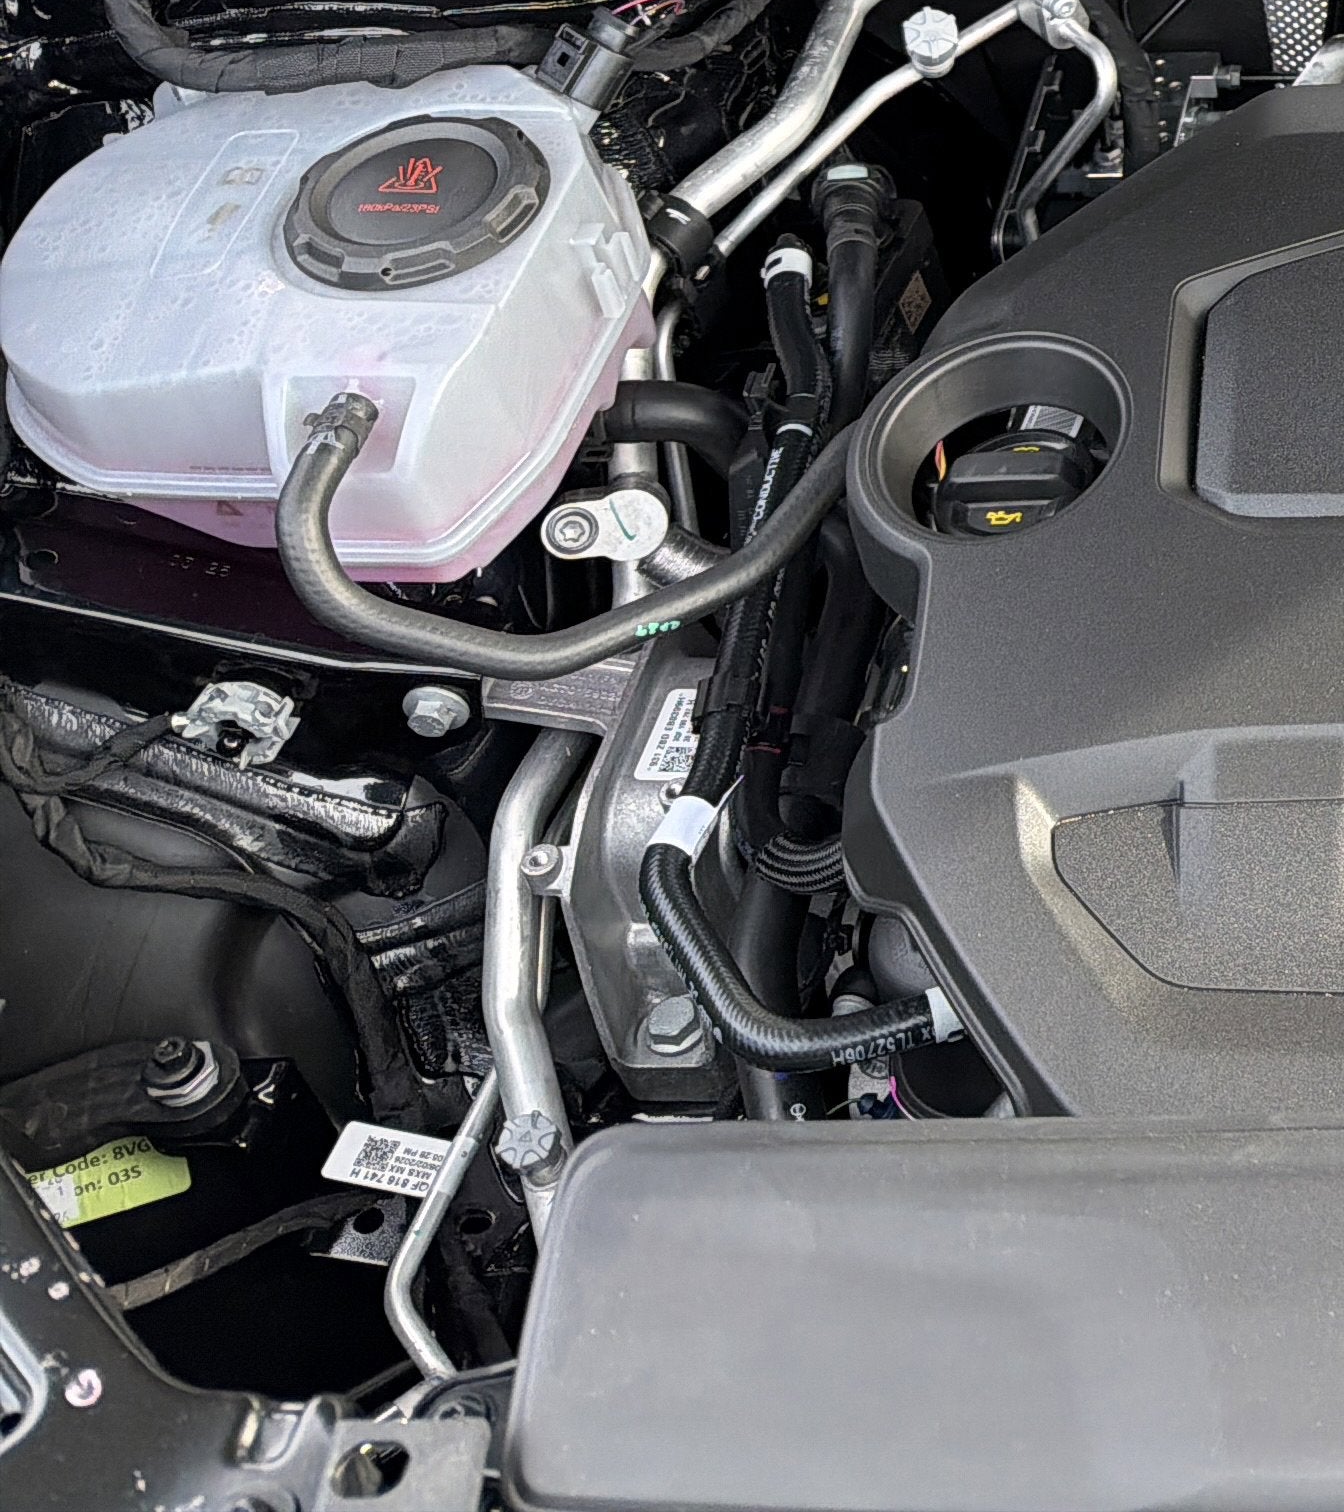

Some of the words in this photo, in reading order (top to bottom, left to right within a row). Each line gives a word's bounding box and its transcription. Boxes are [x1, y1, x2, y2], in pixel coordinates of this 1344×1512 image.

[830, 1026, 919, 1068] TL52706H
[52, 1153, 109, 1178] Code:
[349, 1168, 361, 1178] H
[107, 1164, 142, 1186] 03S
[363, 1170, 386, 1183] 741
[387, 1175, 410, 1188] 816
